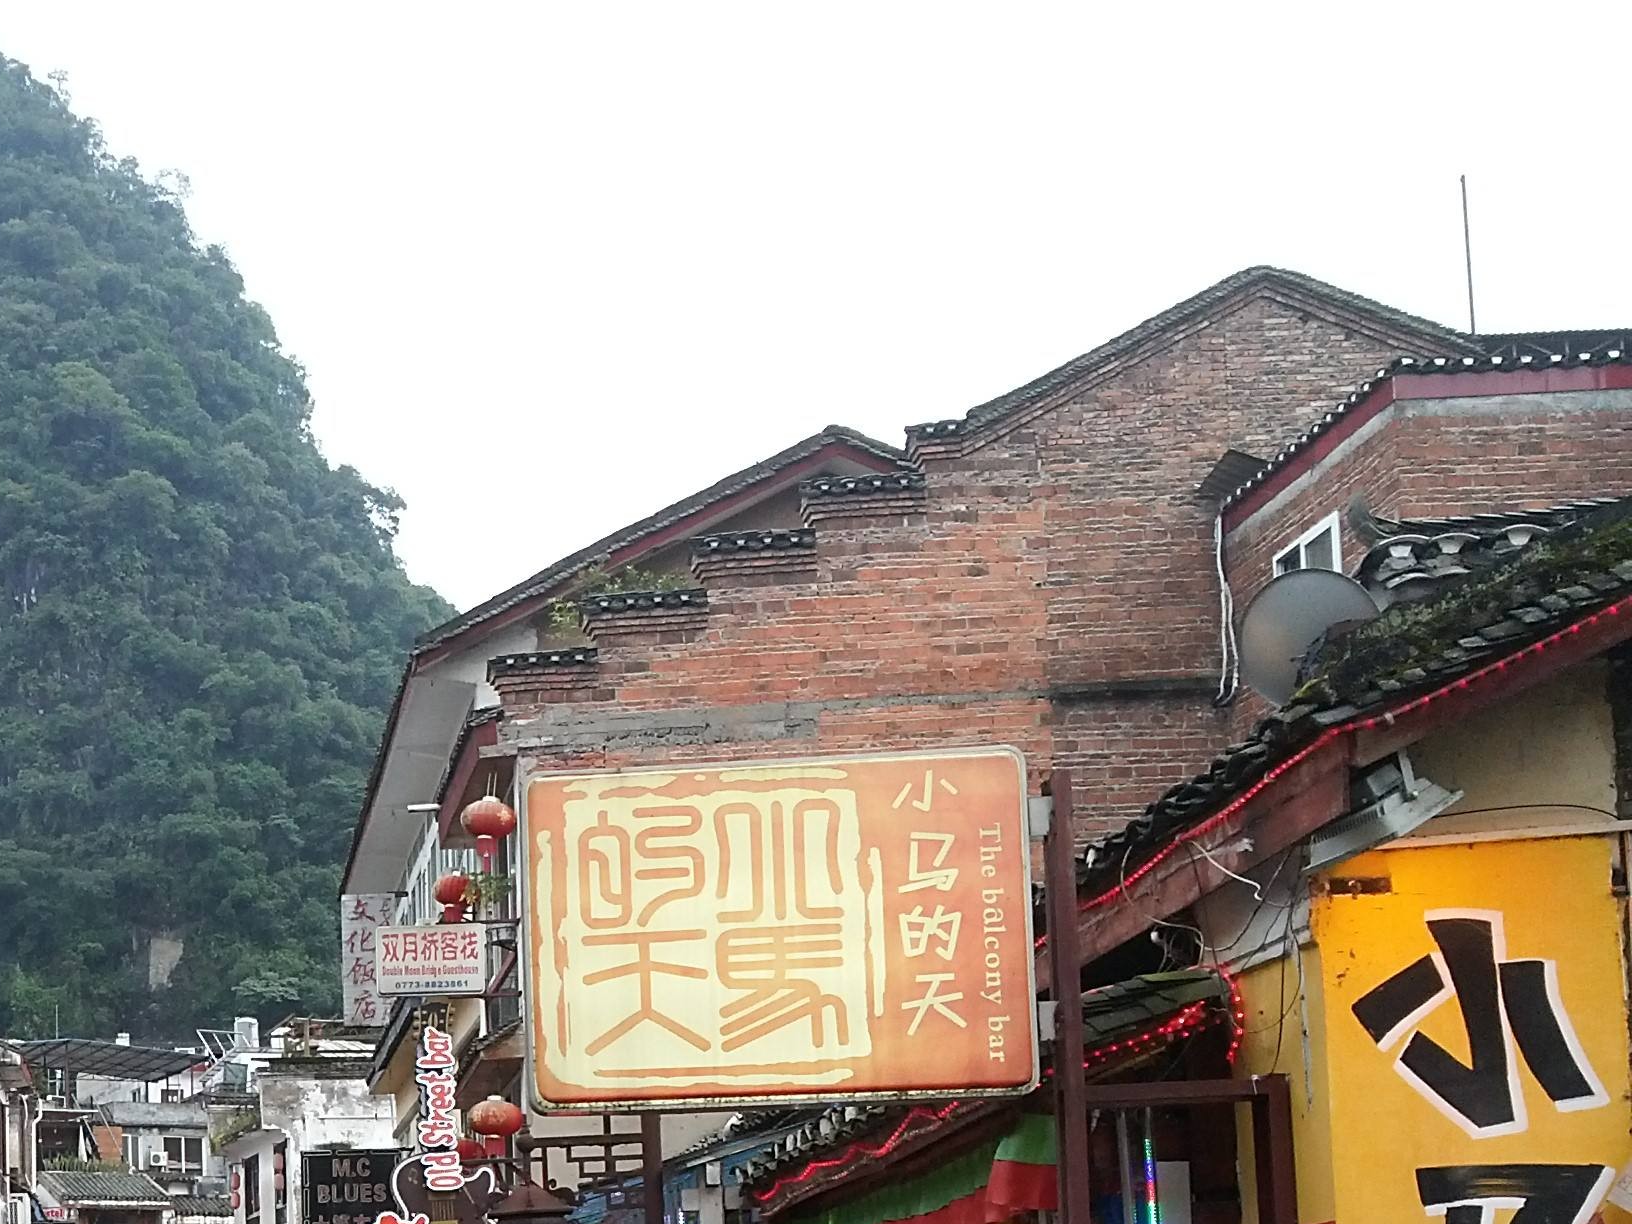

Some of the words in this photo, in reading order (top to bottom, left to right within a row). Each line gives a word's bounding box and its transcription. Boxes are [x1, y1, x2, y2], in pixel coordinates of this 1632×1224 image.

[978, 822, 1003, 879] The
[891, 769, 968, 1037] 小马的天
[381, 930, 480, 963] 双月桥客栈
[980, 887, 1005, 1006] balcony
[417, 1027, 455, 1068] bar
[987, 1012, 1012, 1064] bar
[417, 1071, 456, 1147] street
[331, 1157, 372, 1178] M.C
[423, 1152, 464, 1191] Old
[317, 1183, 387, 1204] BLUES
